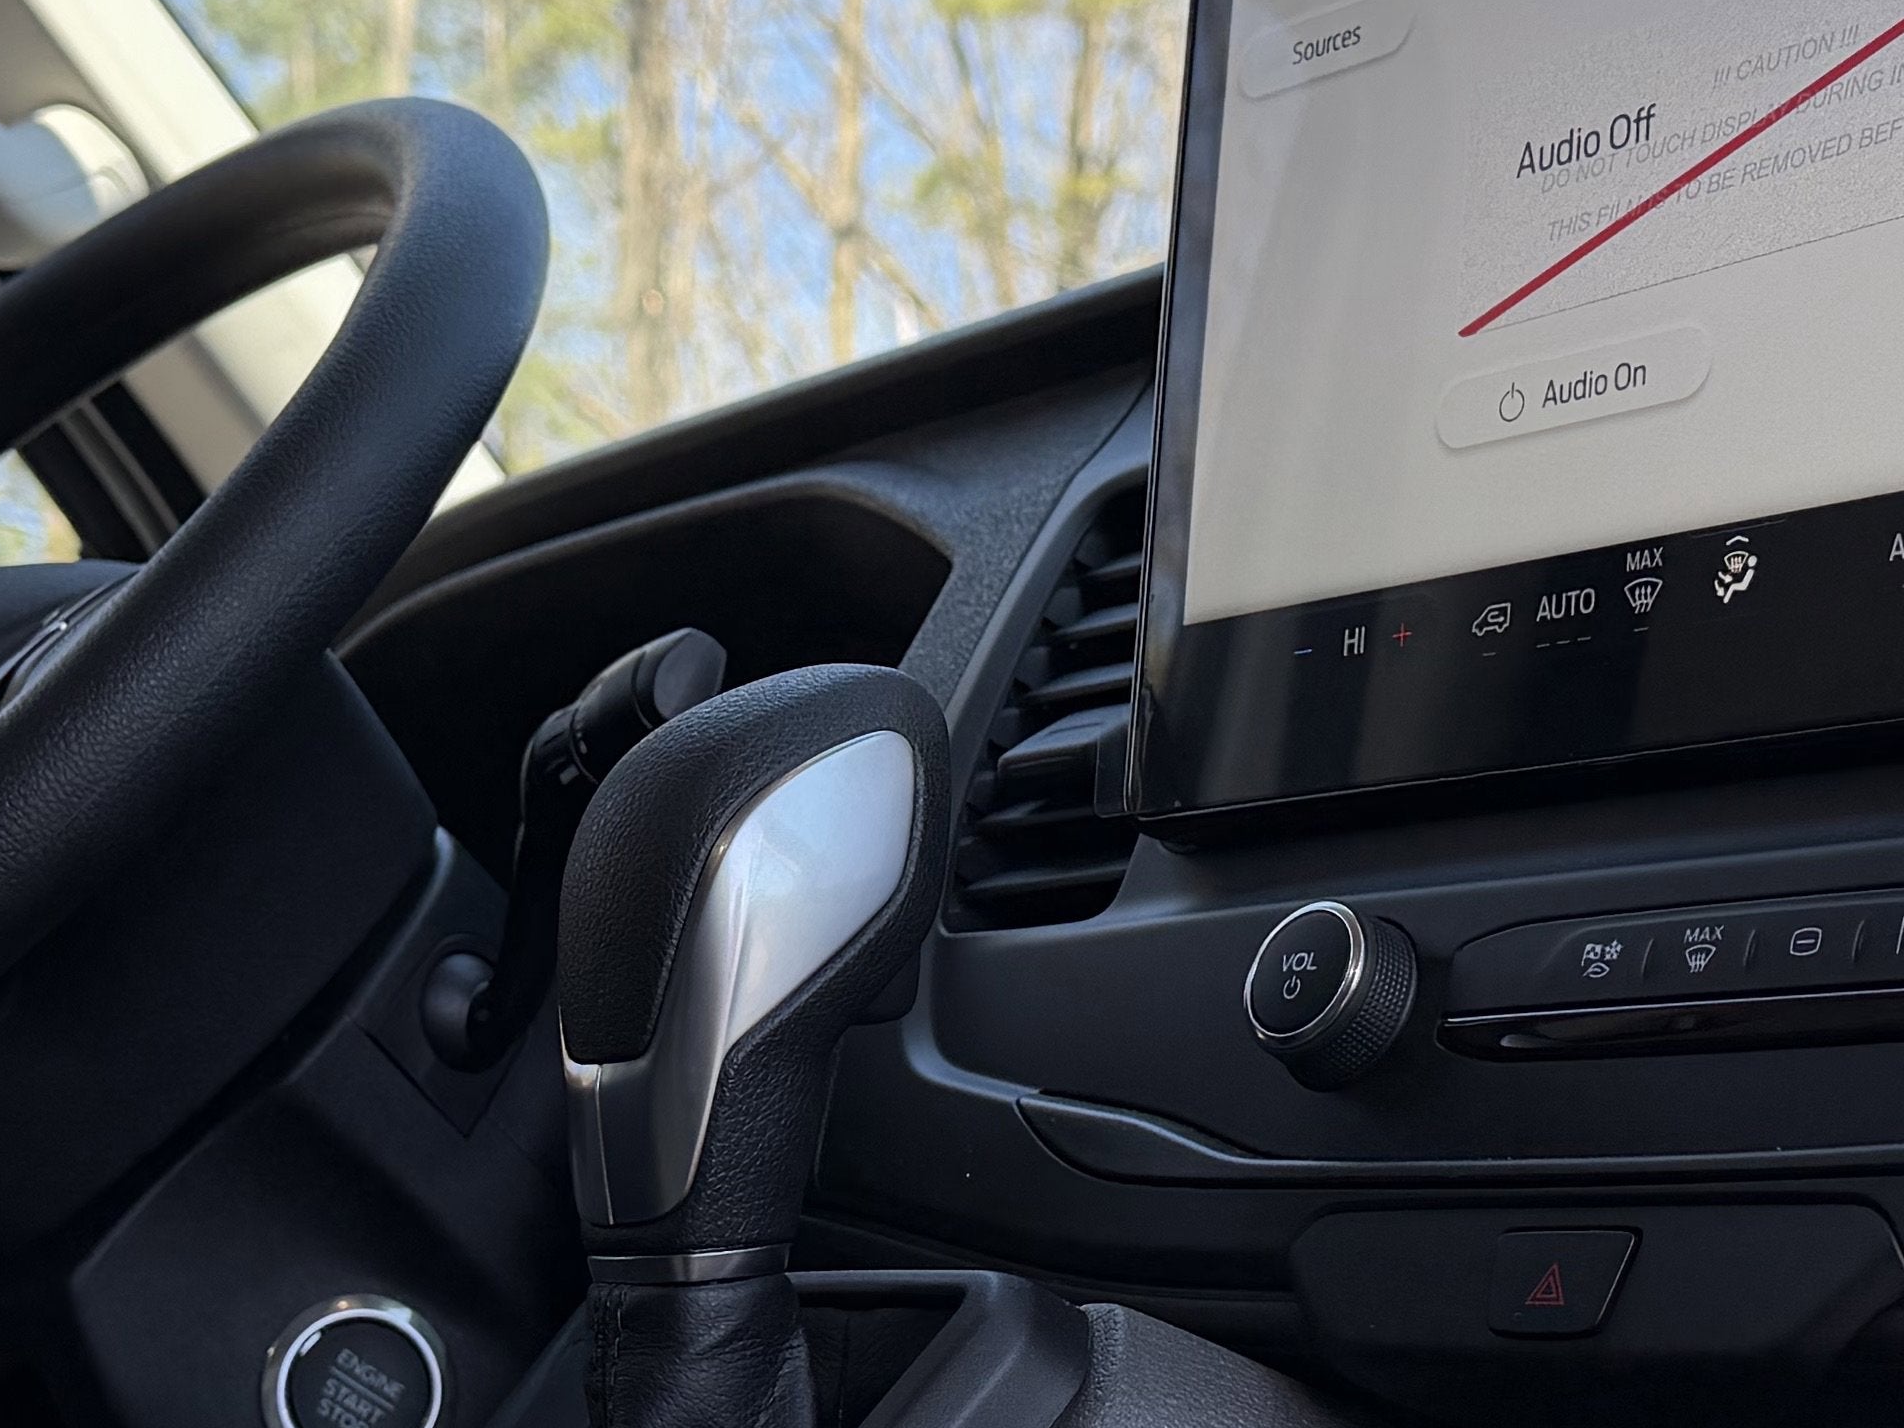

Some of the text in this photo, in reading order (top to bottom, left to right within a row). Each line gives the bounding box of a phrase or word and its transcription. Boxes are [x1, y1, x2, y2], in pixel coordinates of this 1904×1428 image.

[1292, 26, 1362, 66] Sources
[1736, 31, 1834, 81] CAUTION
[1516, 103, 1657, 179] Audio Off
[1541, 170, 1569, 194] DO
[1575, 152, 1618, 183] NOT
[1624, 132, 1696, 170] TOUCH
[1795, 70, 1884, 115] DURING
[1547, 212, 1592, 242] THIS
[1706, 171, 1736, 195] BE
[1740, 132, 1853, 184] REMOVED
[1542, 362, 1647, 408] Audio On
[1626, 546, 1664, 572] MAX
[1535, 587, 1597, 622] AUTO
[1343, 626, 1367, 657] HI
[1683, 925, 1726, 945] MAX
[1282, 953, 1318, 972] VOL
[337, 1348, 405, 1400] ENGINE
[323, 1378, 385, 1425] START
